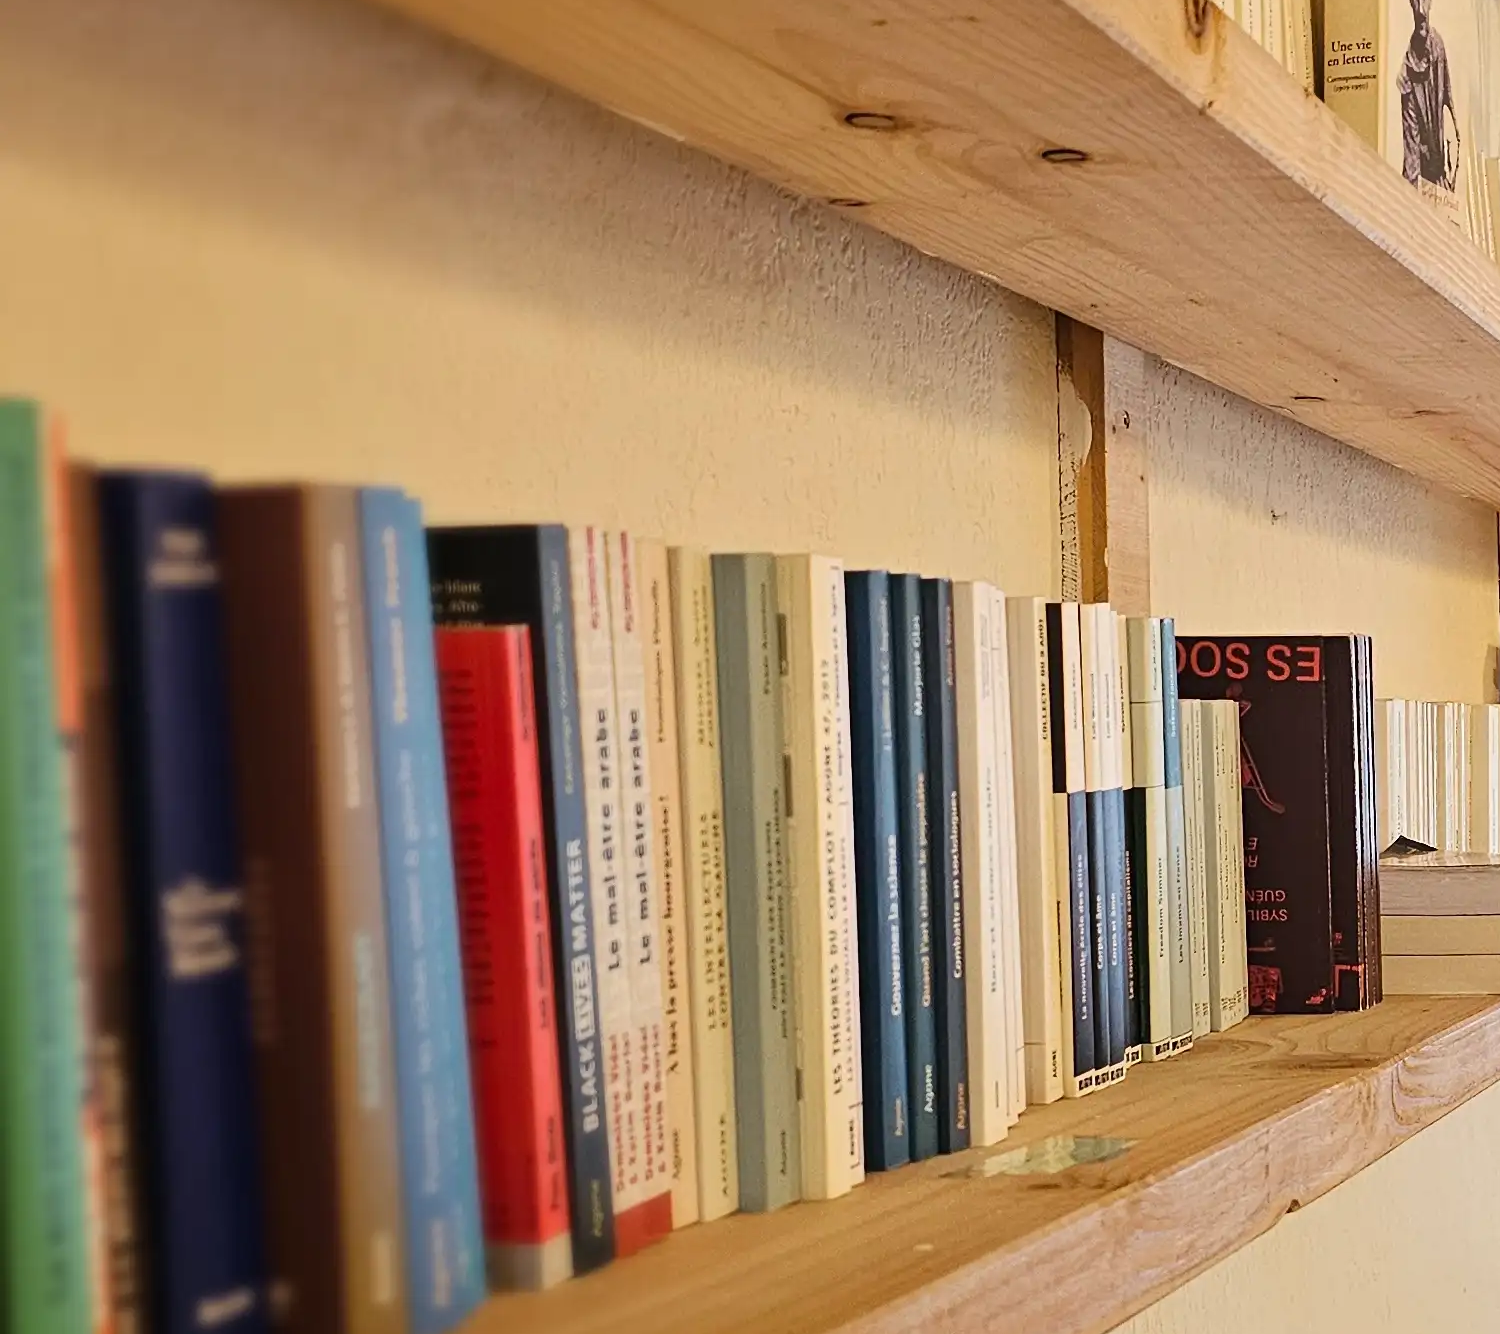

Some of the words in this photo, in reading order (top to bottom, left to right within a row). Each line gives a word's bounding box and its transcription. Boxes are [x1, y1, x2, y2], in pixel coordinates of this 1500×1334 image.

[1327, 57, 1340, 67] en
[1342, 53, 1376, 66] lettres
[1331, 40, 1353, 52] Une
[1356, 38, 1372, 50] vie
[911, 649, 923, 717] Marjorie
[1266, 644, 1321, 682] ES
[1040, 680, 1049, 741] COLLECTIF
[596, 707, 612, 789] arabe
[628, 708, 643, 789] arabe
[950, 790, 961, 876] sociologues
[825, 829, 837, 921] COMPLOT
[886, 834, 899, 900] science
[952, 878, 961, 899] en
[1123, 849, 1133, 913] capitalisme
[1157, 855, 1165, 905] Summer
[566, 838, 588, 952] MATTER
[887, 902, 899, 922] la
[1076, 890, 1085, 914] des
[1176, 885, 1184, 901] en
[828, 928, 838, 955] DU
[953, 901, 965, 979] Combattre
[1077, 915, 1086, 950] école
[1095, 921, 1103, 935] et
[1110, 919, 1117, 932] et
[1125, 913, 1133, 929] du
[1158, 907, 1166, 958] Freedom
[607, 939, 621, 971] Le
[638, 933, 652, 964] Le
[667, 926, 678, 991] presse
[1096, 936, 1104, 970] Corps
[1110, 932, 1118, 967] Corps
[1125, 930, 1135, 979] courtiers
[1177, 943, 1185, 964] Les
[889, 924, 903, 1017] Gouverner
[919, 956, 932, 1008] Quand
[1078, 951, 1088, 1003] nouvelle
[1127, 979, 1136, 1001] Les
[572, 955, 595, 1040] LIVES
[666, 996, 677, 1016] la
[828, 963, 842, 1057] THÉORIES
[1081, 1005, 1088, 1021] La
[669, 1020, 679, 1055] bas
[579, 1041, 600, 1134] BLACK
[831, 1064, 843, 1096] LES
[924, 1063, 935, 1114] Agone
[956, 1082, 966, 1130] Agone
